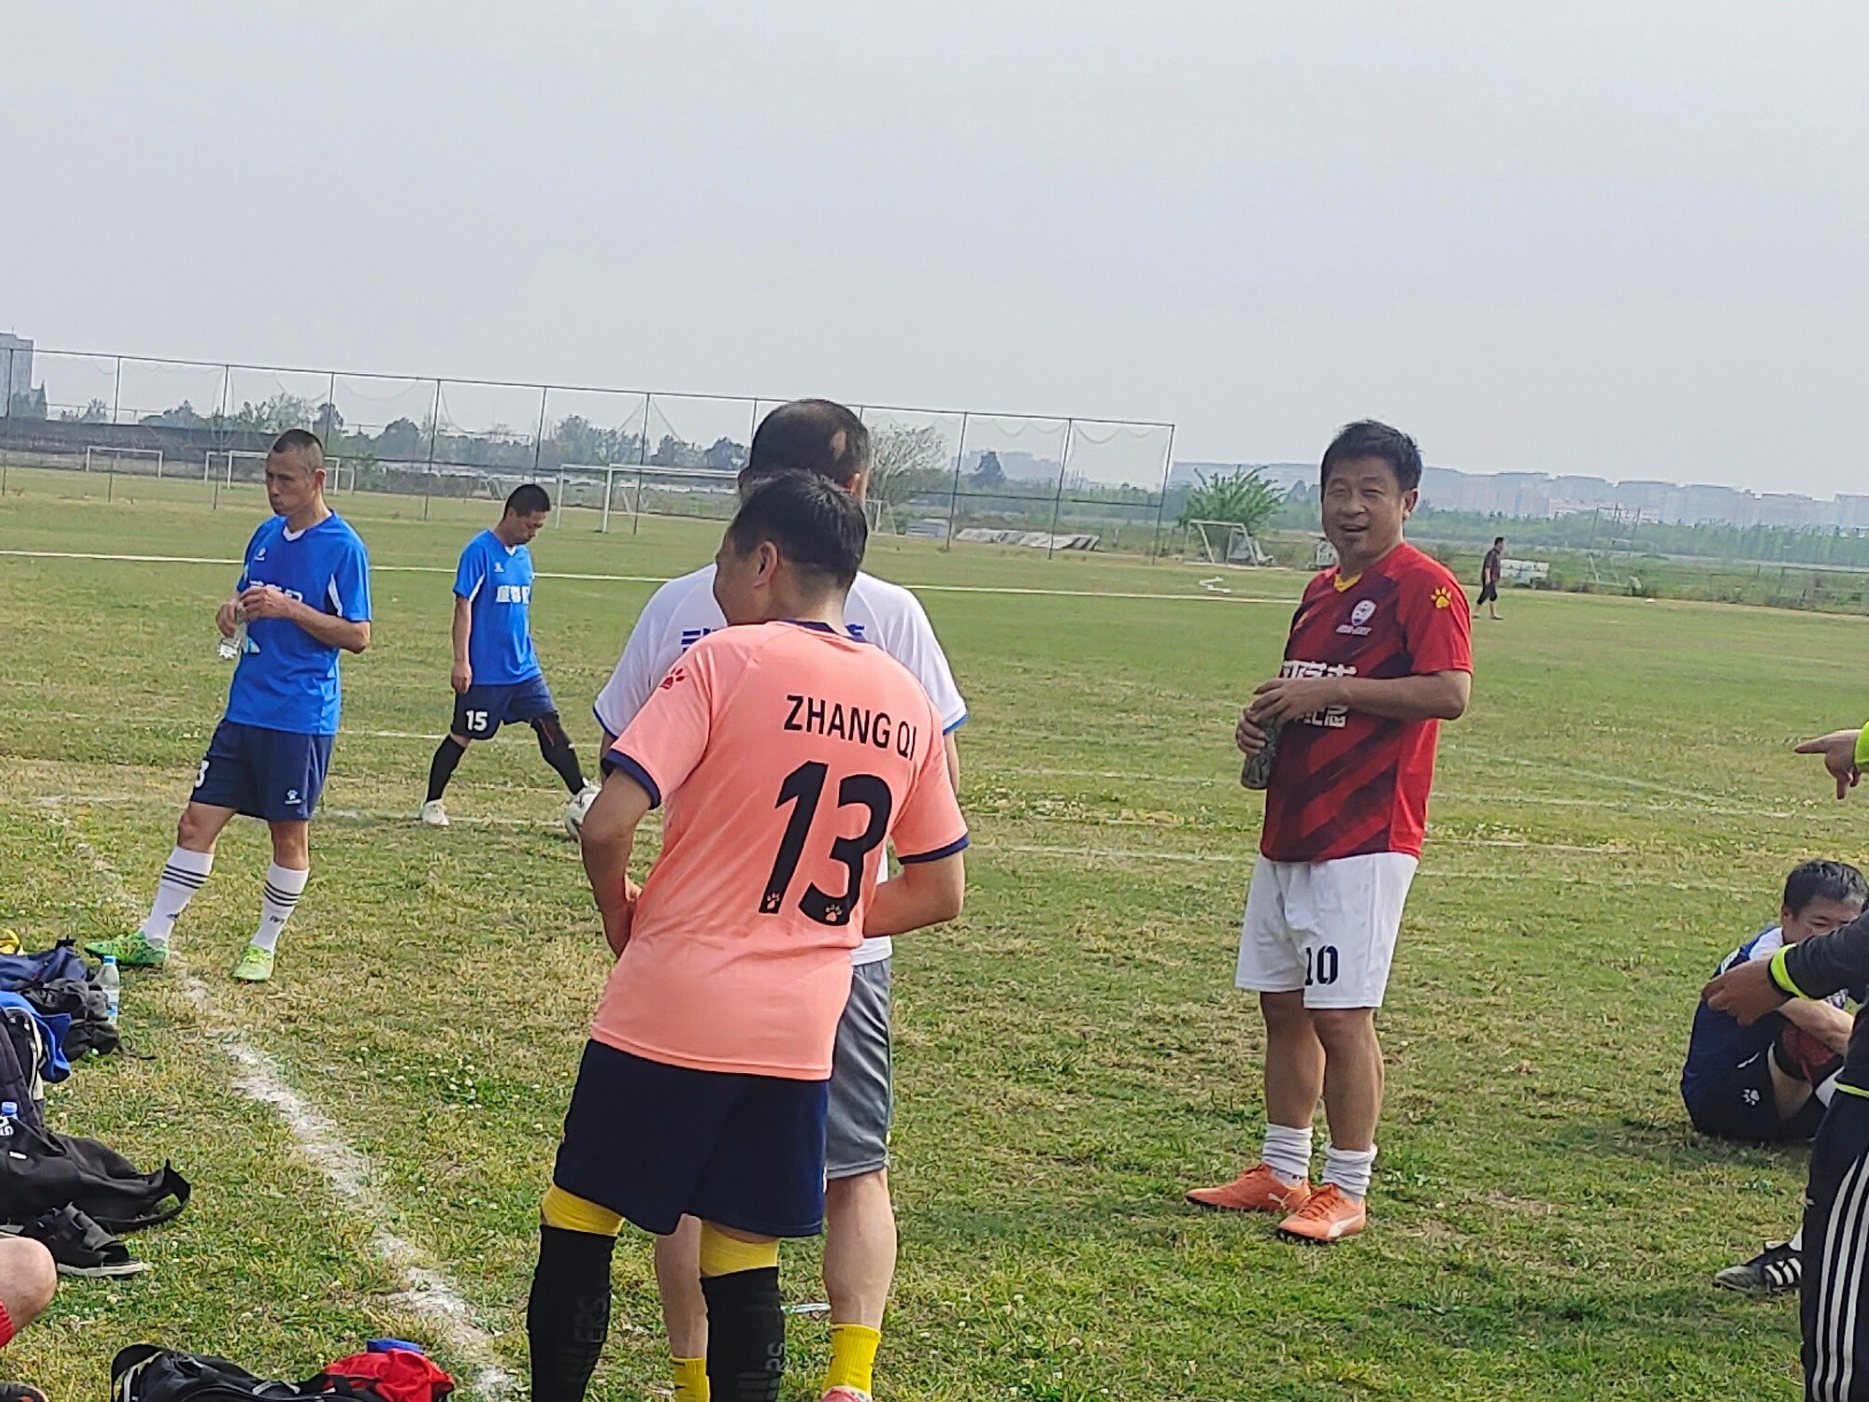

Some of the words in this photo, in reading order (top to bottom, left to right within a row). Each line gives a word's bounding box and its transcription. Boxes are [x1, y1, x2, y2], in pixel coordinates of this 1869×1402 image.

[466, 710, 488, 732] 15
[783, 694, 892, 749] ZHANG
[896, 720, 917, 761] QI
[758, 760, 893, 926] 13
[1304, 944, 1339, 986] 10
